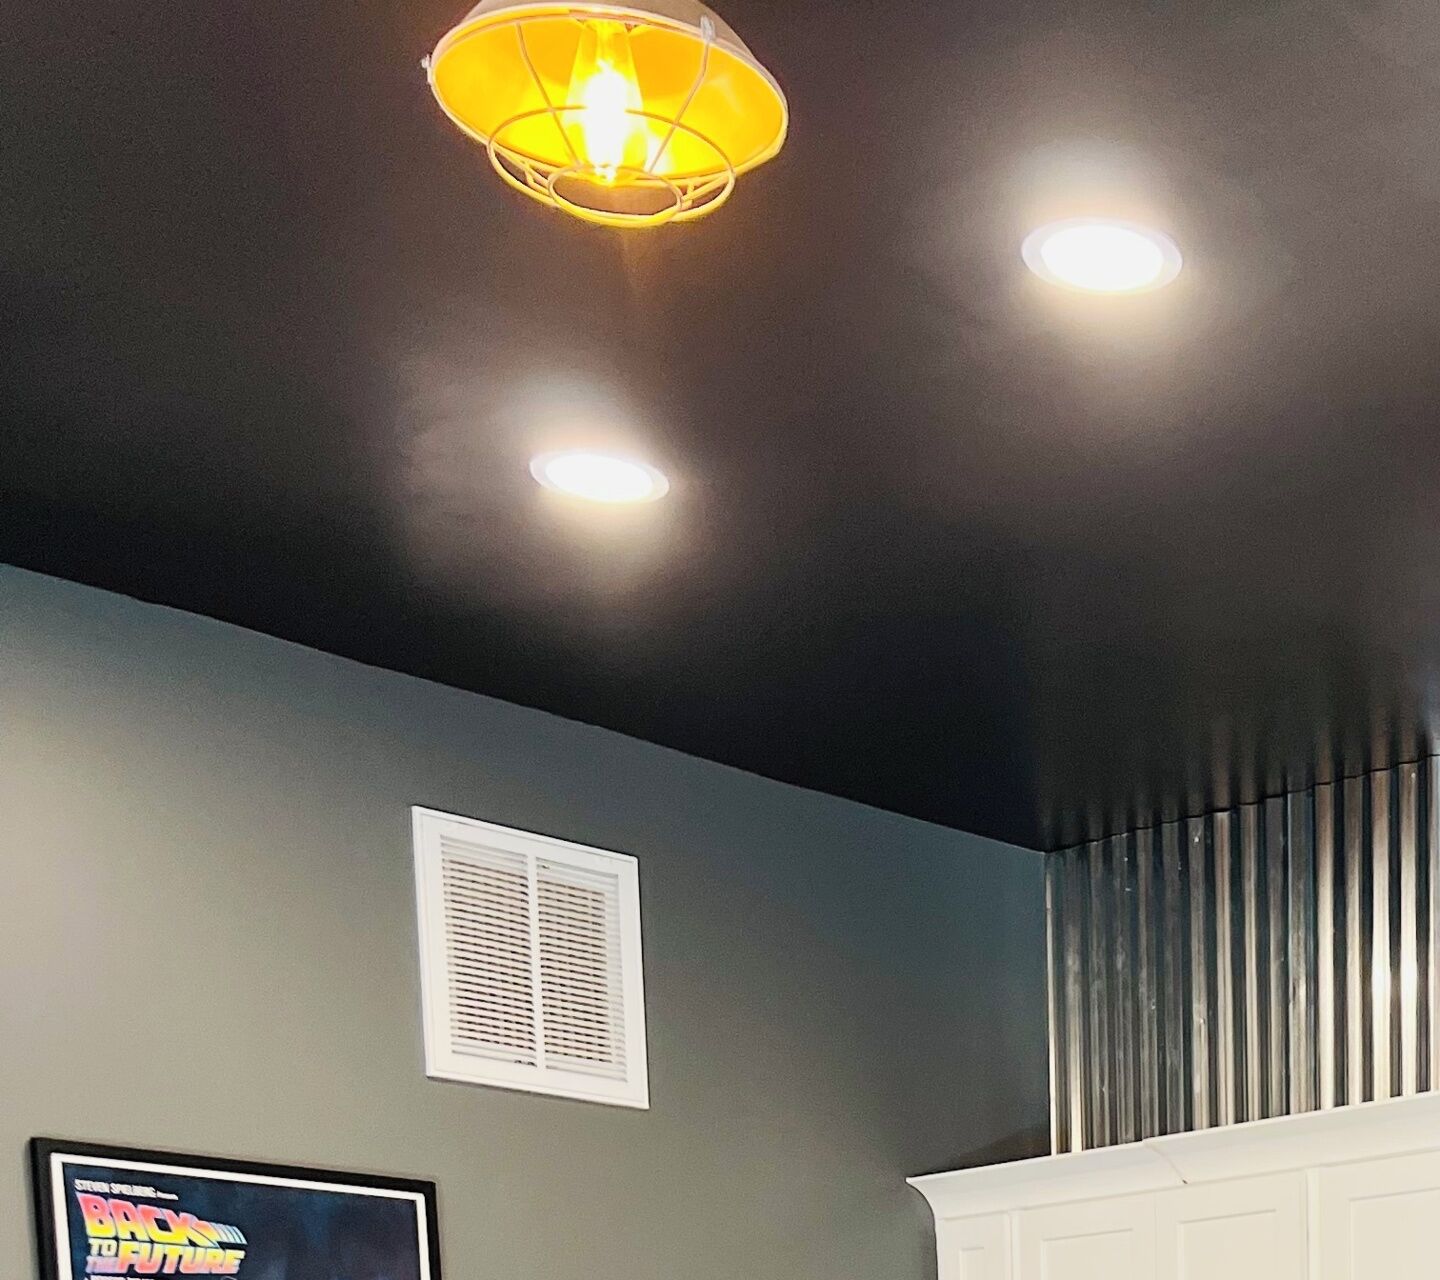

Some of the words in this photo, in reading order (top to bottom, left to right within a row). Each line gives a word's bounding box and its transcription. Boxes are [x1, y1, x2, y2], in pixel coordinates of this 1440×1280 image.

[75, 1191, 224, 1249] BACK
[88, 1238, 117, 1257] TO
[116, 1240, 247, 1275] FUTURE
